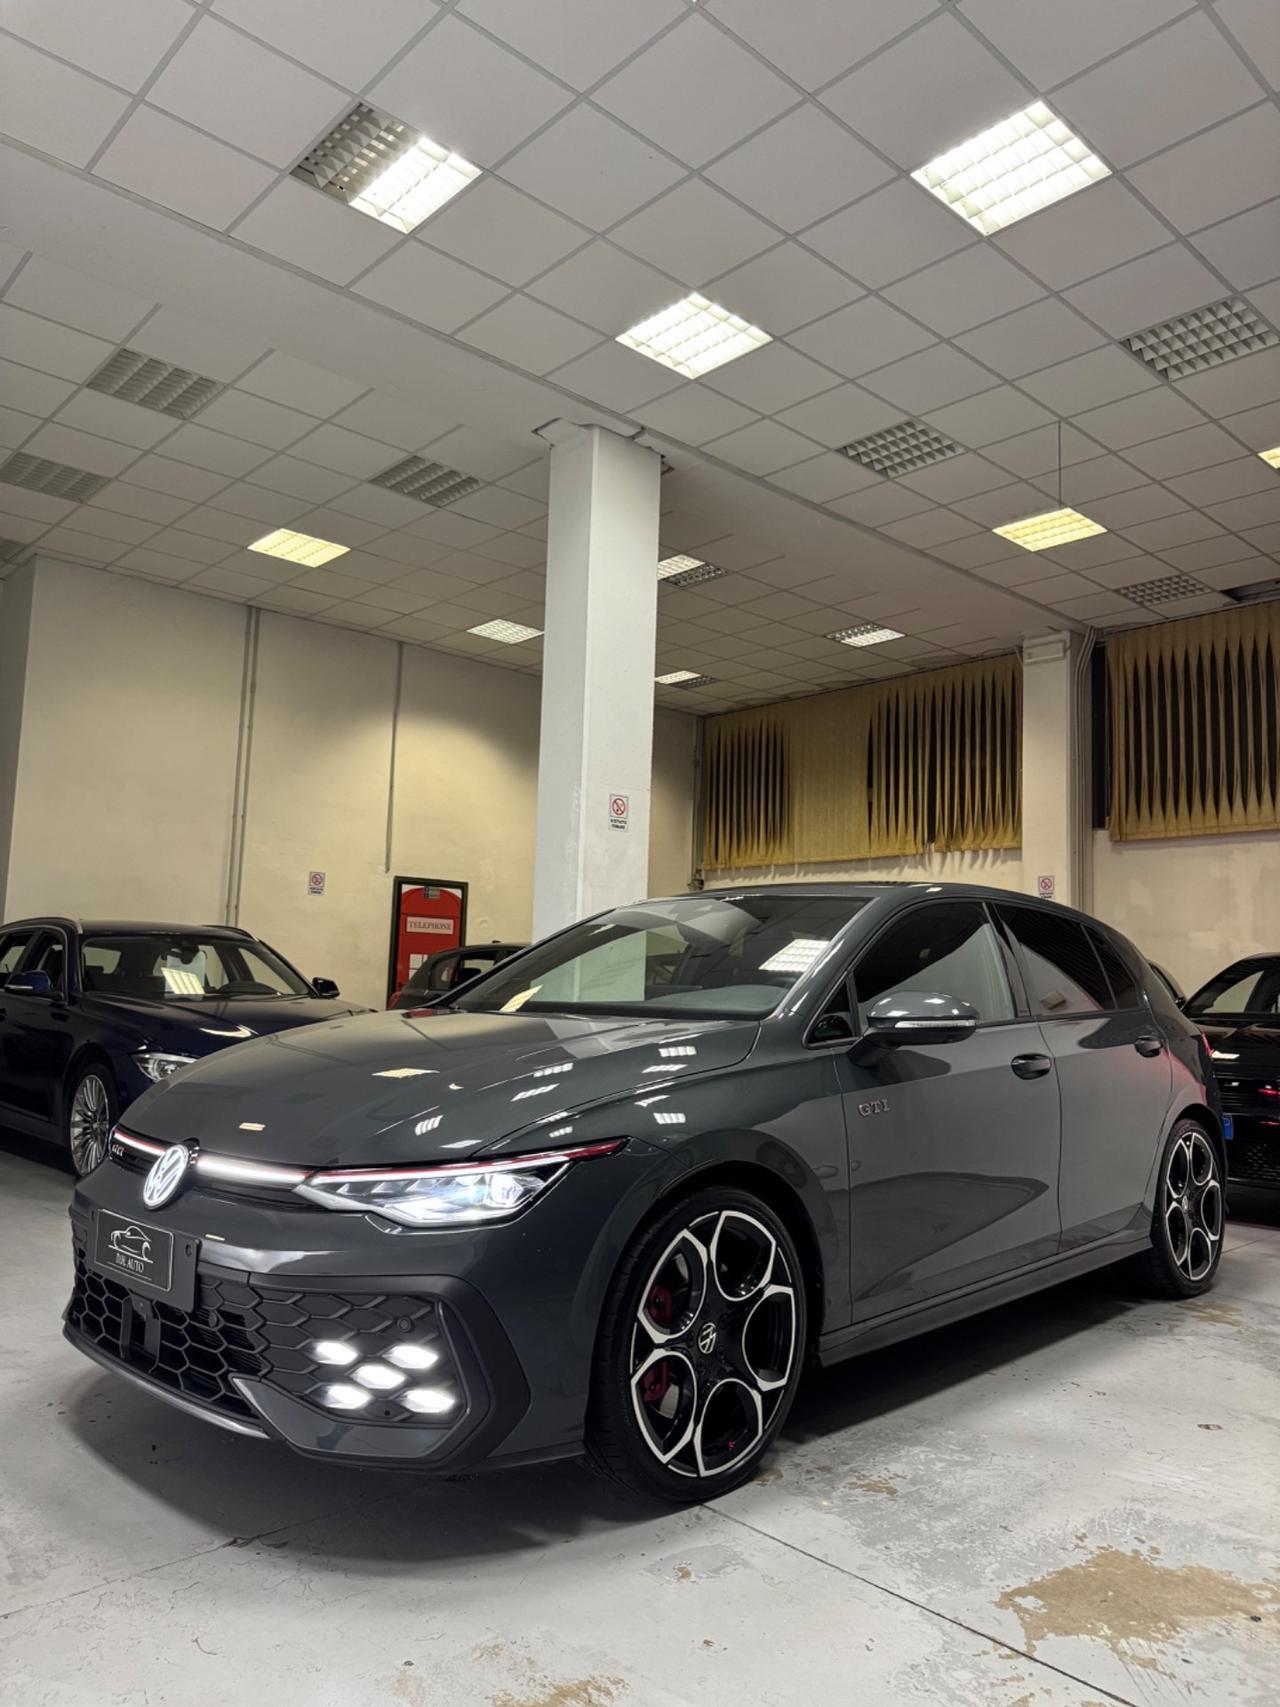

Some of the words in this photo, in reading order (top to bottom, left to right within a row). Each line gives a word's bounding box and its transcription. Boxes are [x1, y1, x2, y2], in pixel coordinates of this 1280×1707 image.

[408, 920, 452, 931] TELEPHONE
[858, 1098, 891, 1117] GTI
[127, 1257, 145, 1274] AUTO
